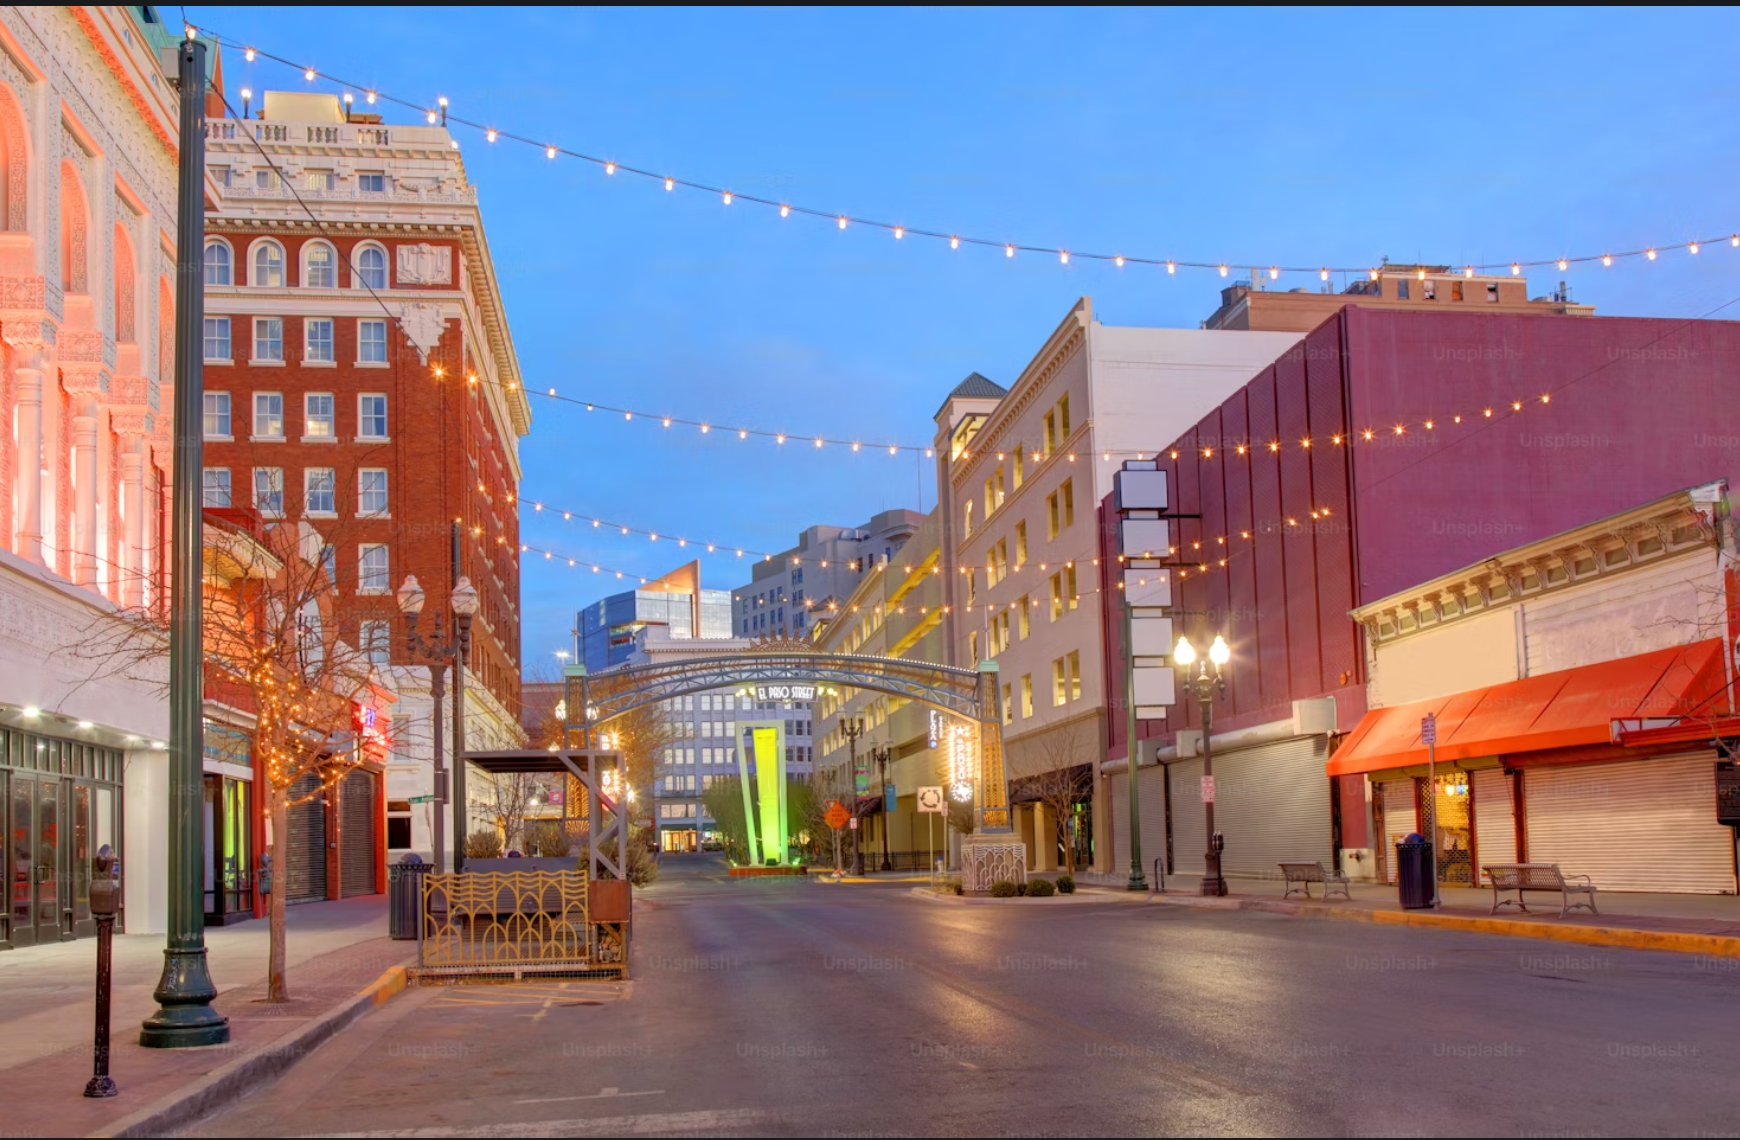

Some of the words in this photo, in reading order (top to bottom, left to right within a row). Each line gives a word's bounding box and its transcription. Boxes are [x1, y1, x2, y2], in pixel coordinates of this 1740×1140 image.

[758, 687, 767, 700] EL
[769, 686, 789, 699] PASO
[791, 687, 814, 699] STREET
[957, 745, 966, 779] PASO
